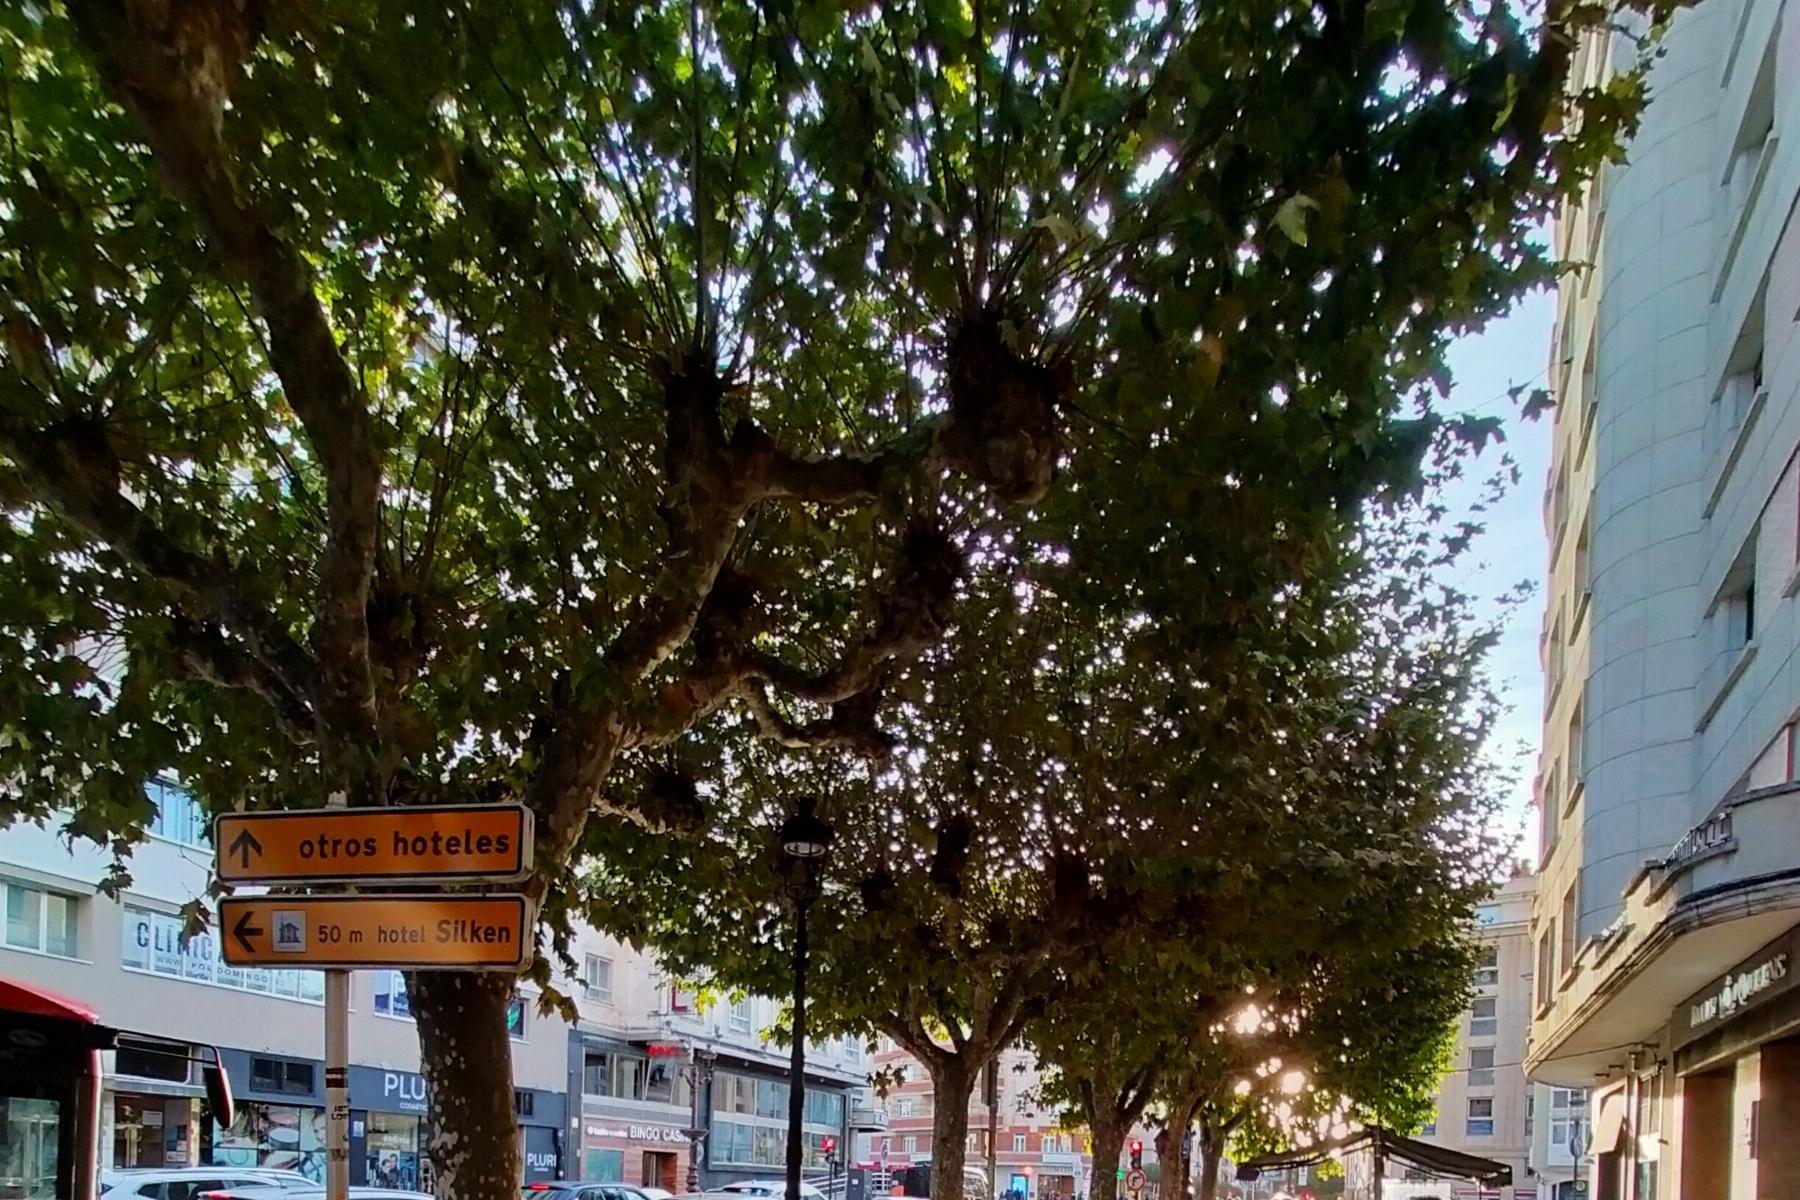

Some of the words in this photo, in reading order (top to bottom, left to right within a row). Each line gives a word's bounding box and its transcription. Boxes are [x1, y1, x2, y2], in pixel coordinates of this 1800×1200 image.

[300, 834, 376, 859] otros
[393, 829, 510, 856] hoteles
[318, 925, 341, 943] 50
[350, 930, 363, 943] m
[378, 926, 425, 944] hotel
[436, 919, 511, 944] Silken
[630, 1126, 660, 1140] BINGO
